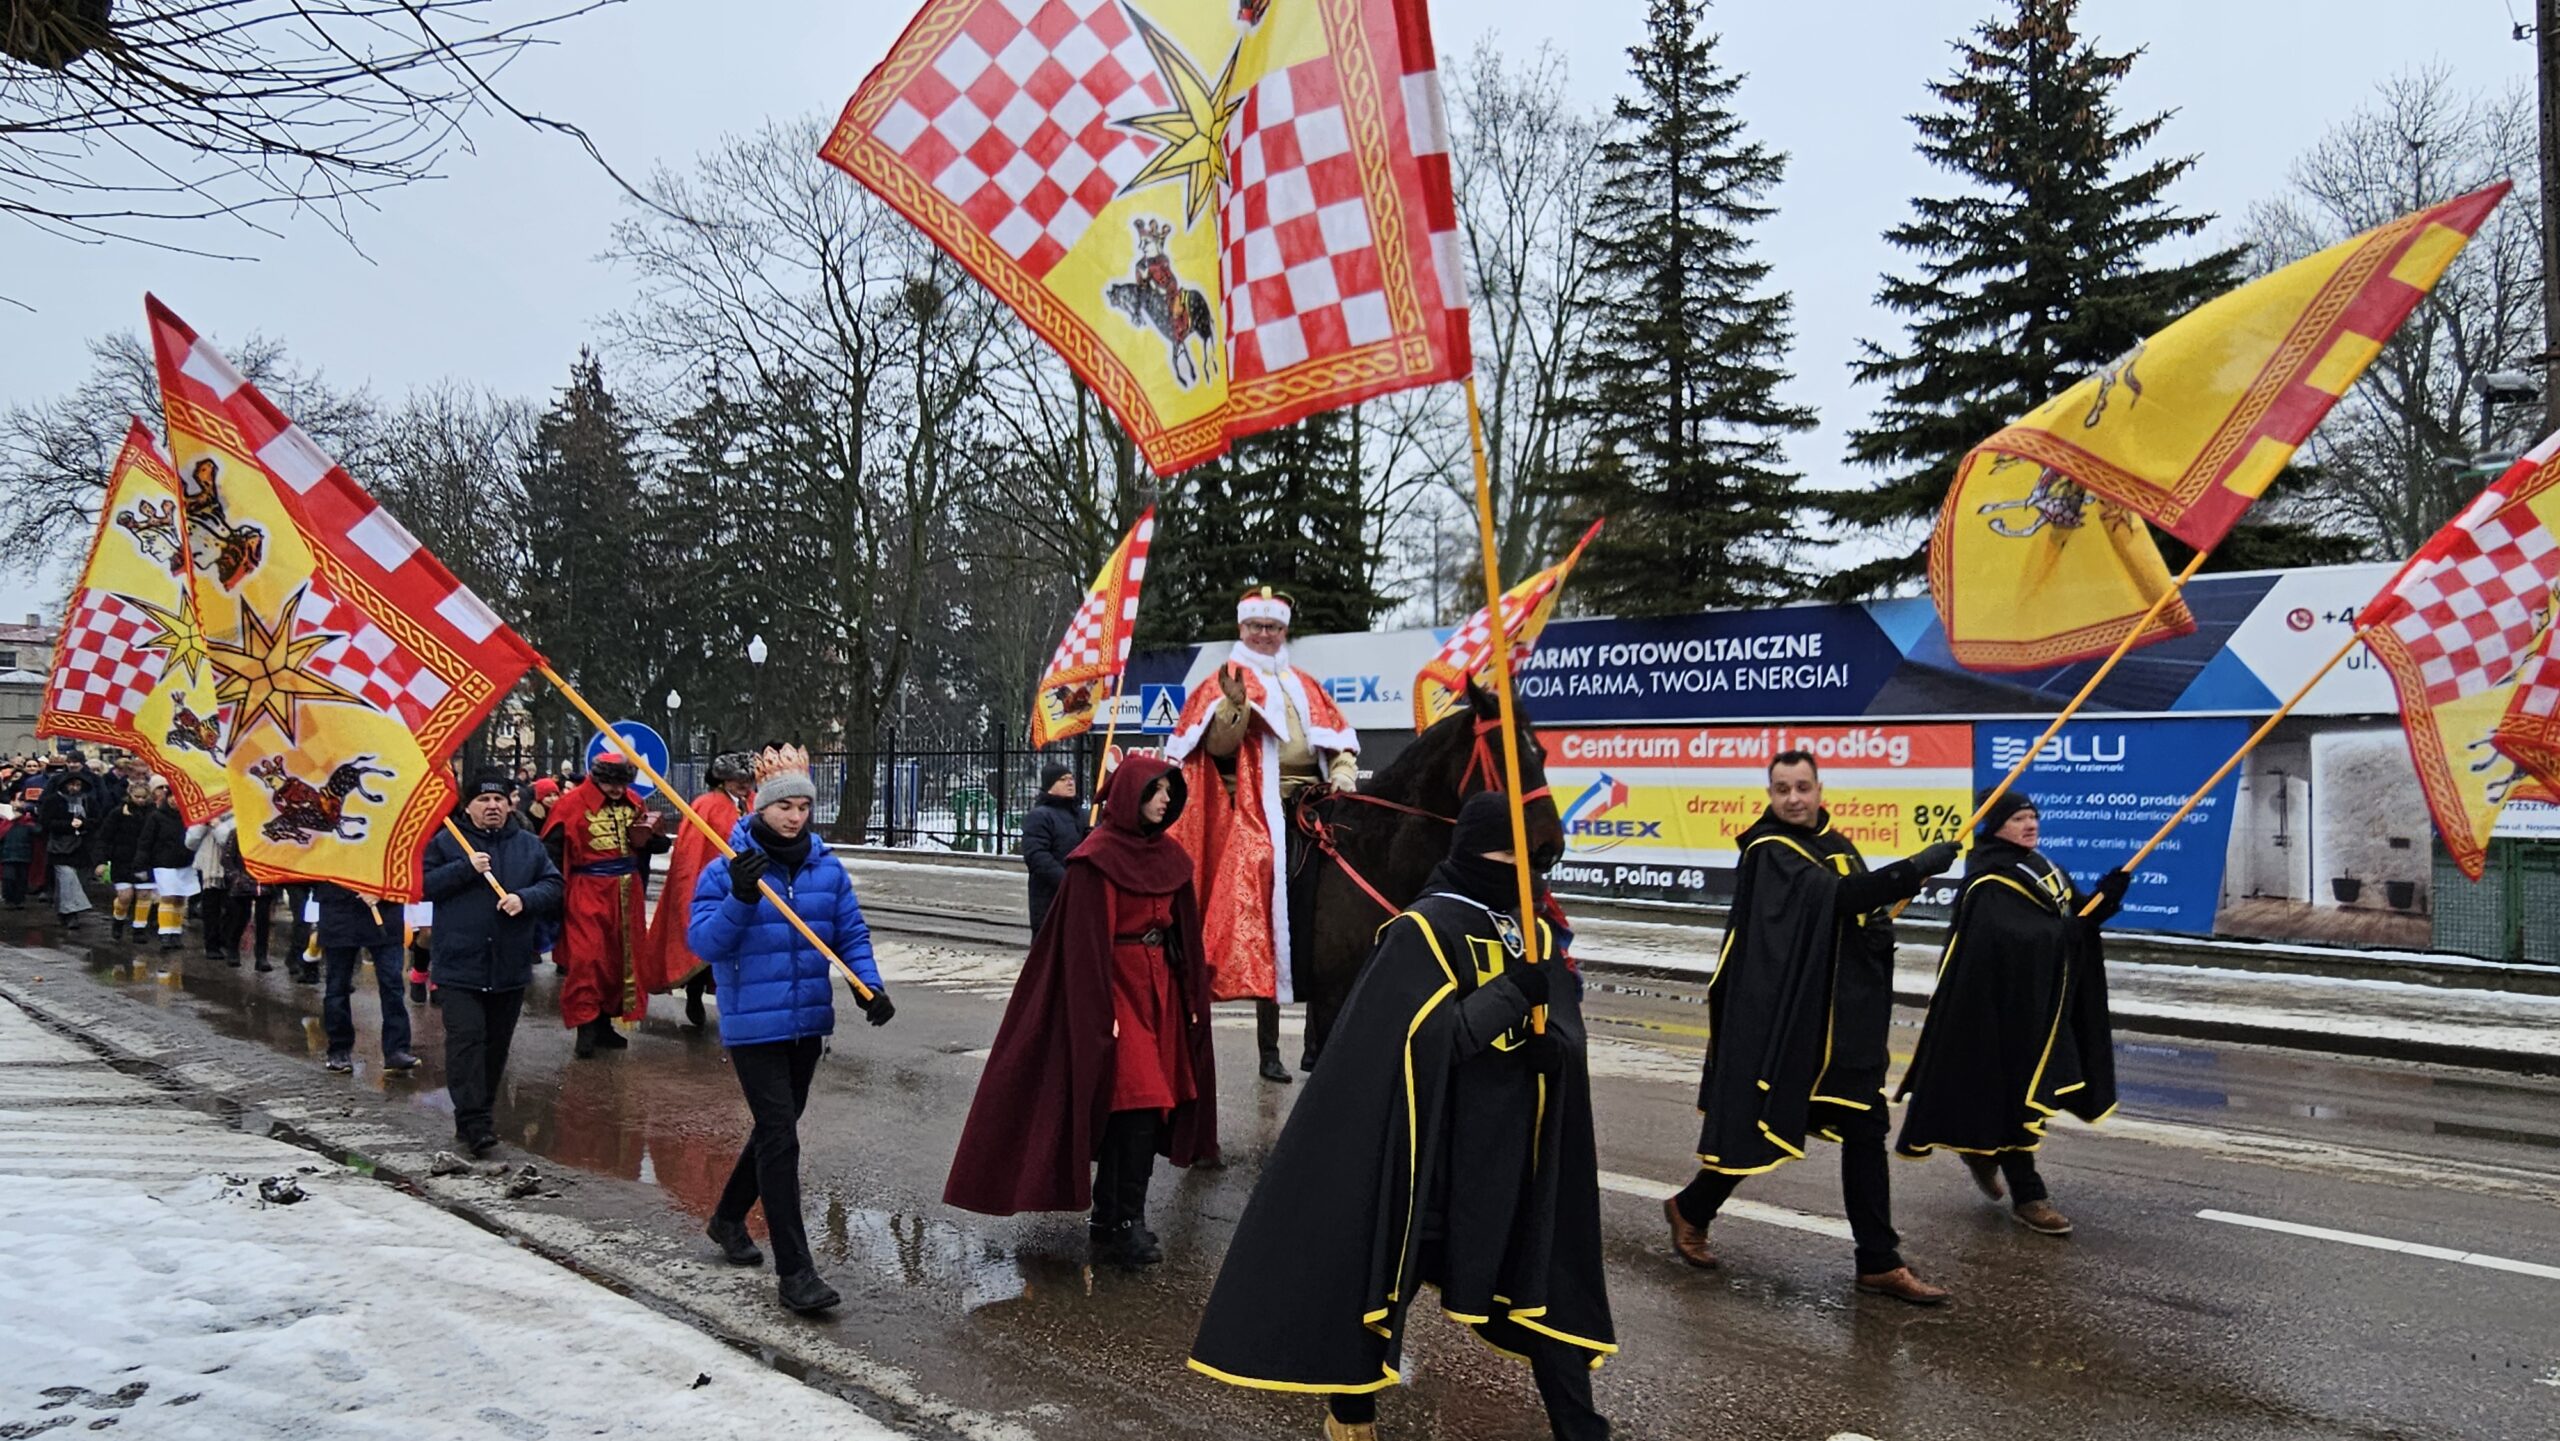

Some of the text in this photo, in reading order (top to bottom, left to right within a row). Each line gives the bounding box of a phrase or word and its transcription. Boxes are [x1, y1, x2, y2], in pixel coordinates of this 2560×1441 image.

[1598, 633, 1823, 668] FOTOWOLTAICZNE
[2347, 645, 2377, 671] ul.
[1569, 673, 1644, 698] FARMA,
[1649, 668, 1729, 694] TWOJA
[1735, 663, 1849, 692] ENERGIA!
[1562, 733, 1680, 760] Centrum
[1688, 729, 1770, 759] drzwi
[2033, 734, 2126, 762] BLU
[2033, 763, 2071, 773] salony
[1686, 794, 1744, 814] drzwi
[2028, 792, 2073, 807] Wybór
[2086, 792, 2105, 806] 40
[2108, 792, 2137, 806] 000
[1914, 804, 1962, 827] 8%
[1917, 827, 1960, 844] VAT
[2037, 836, 2074, 849] rojekt
[1614, 865, 1673, 888] Polna
[1677, 868, 1705, 890] 48
[2142, 871, 2168, 885] 72h
